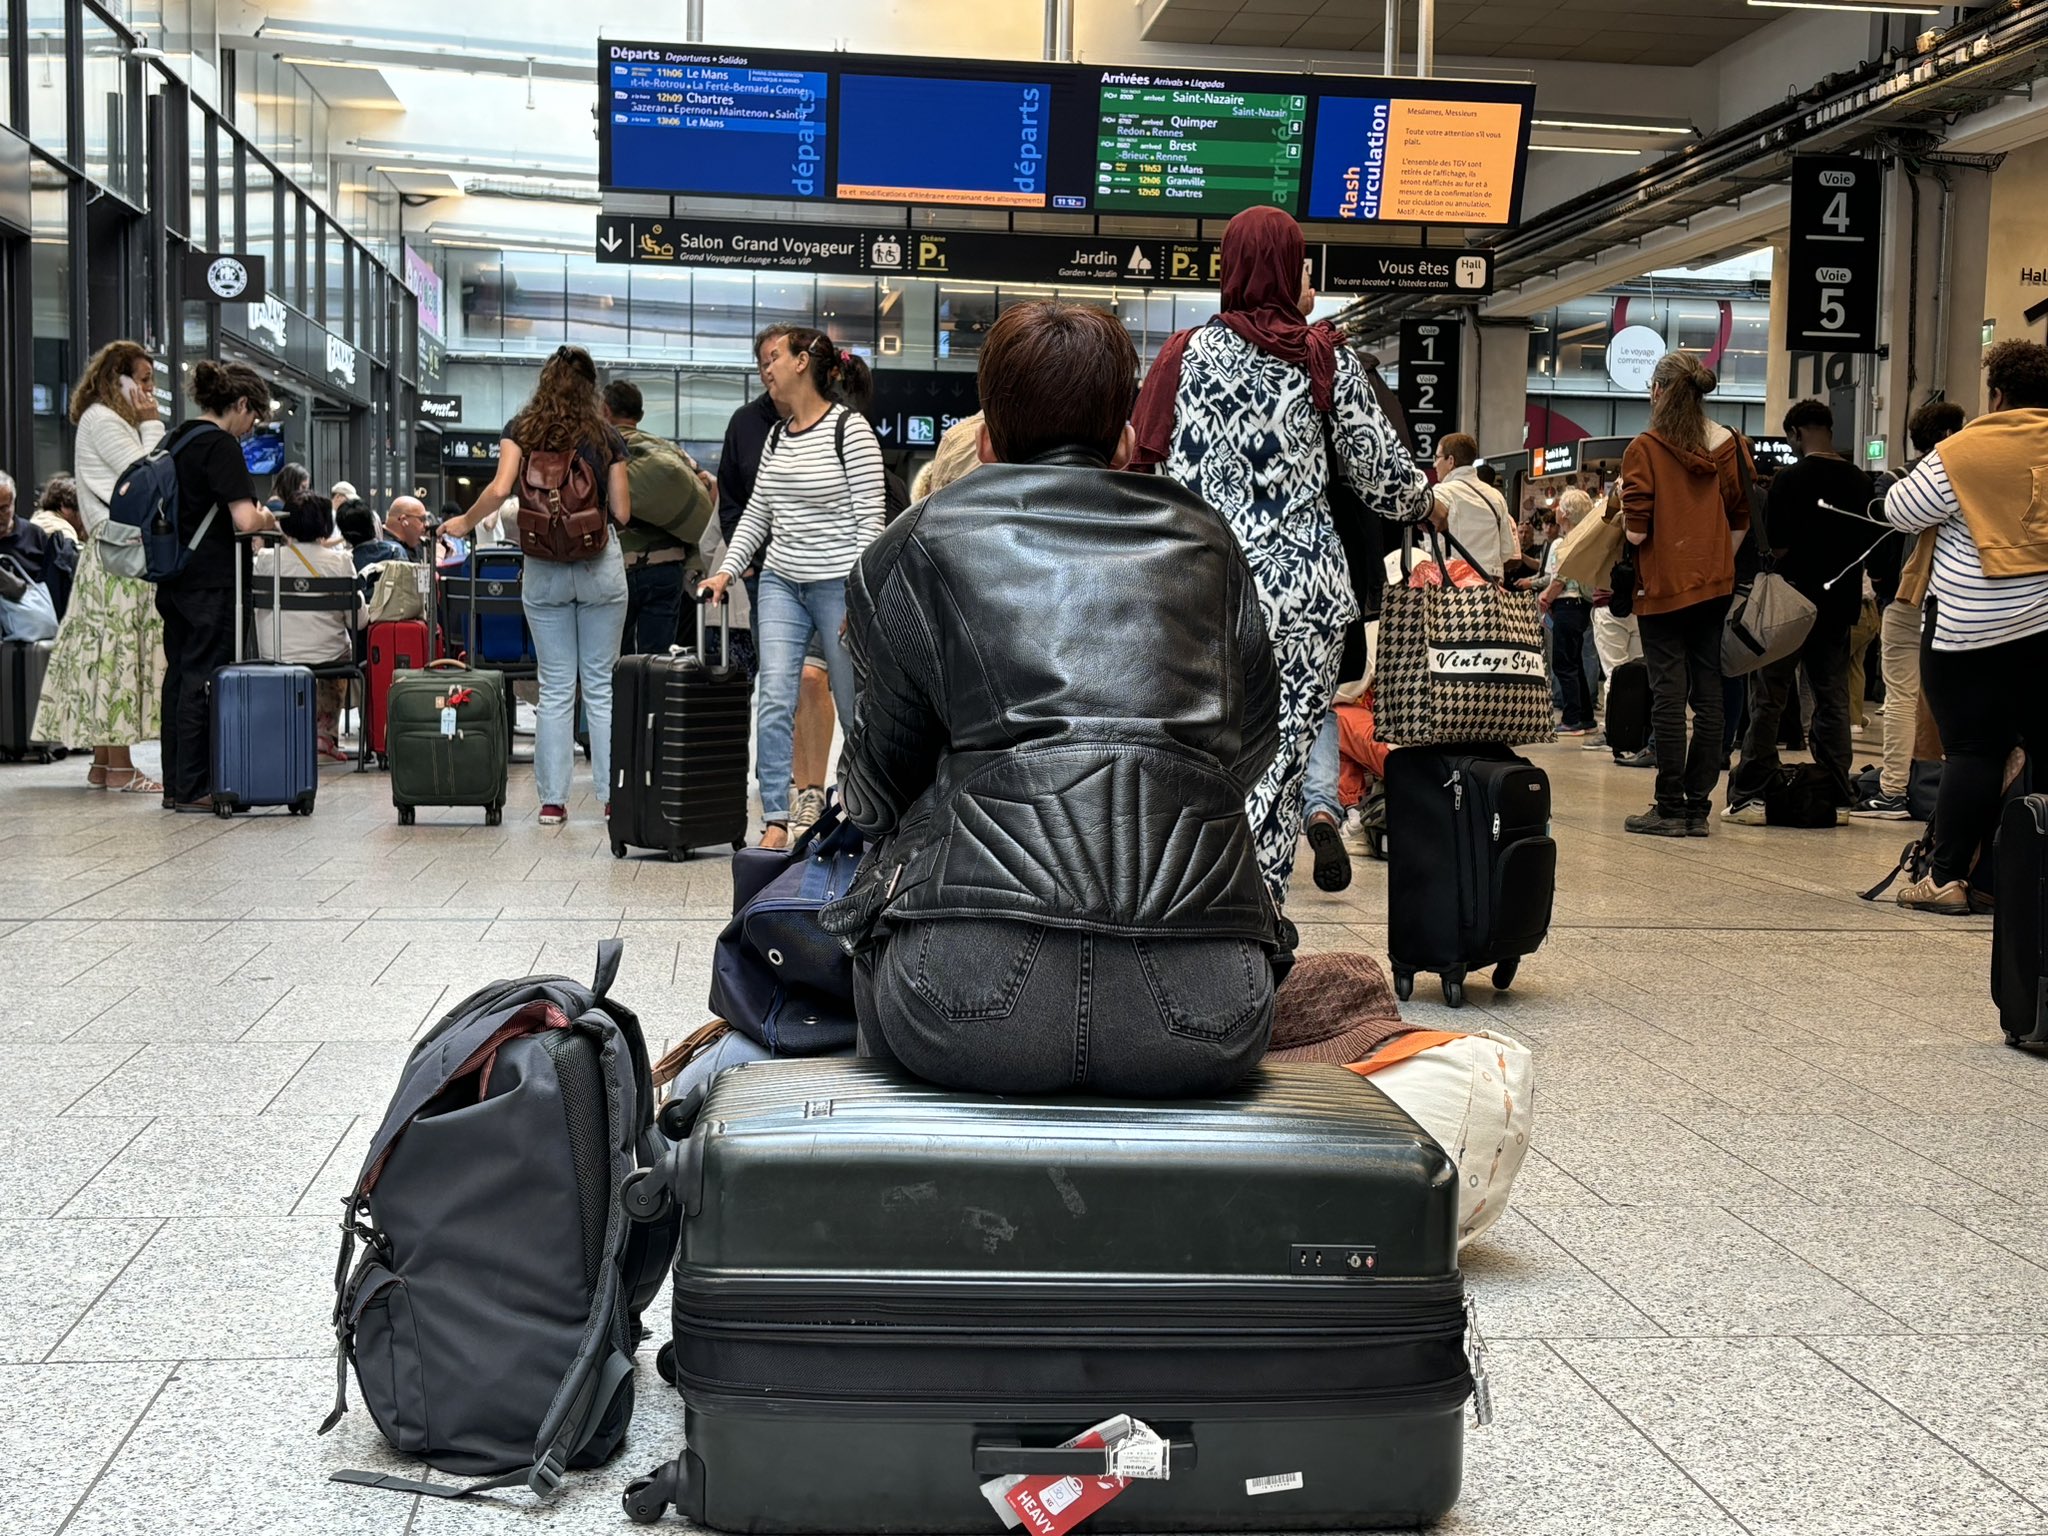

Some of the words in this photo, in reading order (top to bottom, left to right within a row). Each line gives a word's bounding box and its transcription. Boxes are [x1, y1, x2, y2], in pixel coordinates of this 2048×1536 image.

[611, 46, 660, 61] Départs
[666, 52, 710, 63] Departures
[718, 55, 748, 65] Salidas
[657, 68, 683, 78] 11h06
[687, 68, 699, 78] Le
[701, 69, 728, 80] Mans
[1101, 72, 1150, 85] Arrivées
[1153, 77, 1183, 86] Arrivals
[693, 81, 703, 90] La
[706, 81, 769, 93] Ferté-Bernard
[657, 93, 683, 102] 12h09
[686, 92, 734, 105] Chartres
[1172, 91, 1244, 105] Saint-Nazaire
[1294, 98, 1301, 107] 4
[674, 104, 712, 115] Epernon
[720, 107, 768, 118] Maintenon
[1445, 108, 1478, 117] Messieurs
[686, 117, 698, 126] Le
[700, 118, 724, 128] Mans
[1171, 116, 1218, 130] Quimper
[1293, 122, 1299, 131] 8
[1117, 126, 1145, 136] Redon
[1152, 127, 1184, 137] Rennes
[1405, 127, 1424, 136] Toute
[1444, 129, 1474, 138] attention
[792, 89, 820, 195] départs
[1013, 88, 1042, 193] départs
[1169, 140, 1197, 151] Brest
[1290, 147, 1297, 155] 8
[1156, 152, 1187, 161] Rennes
[1360, 104, 1387, 219] circulation
[1402, 158, 1439, 166] L'ensemble
[1439, 159, 1452, 167] des
[1167, 164, 1179, 173] Le
[1180, 165, 1203, 174] Mans
[1401, 168, 1422, 176] retirés
[1468, 170, 1476, 178] ils
[1166, 176, 1205, 186] Granville
[1464, 180, 1474, 188] fur
[1824, 173, 1850, 185] Voie
[1165, 188, 1203, 198] Chartres
[1339, 166, 1360, 218] flash
[1424, 188, 1432, 196] de
[1441, 189, 1482, 198] confirmation
[1484, 190, 1493, 198] de
[1397, 198, 1411, 206] leur
[1822, 192, 1850, 233] 4
[680, 233, 723, 249] Salon
[731, 235, 778, 252] Grand
[782, 238, 855, 257] Voyageur
[679, 252, 705, 262] Grand
[706, 253, 742, 264] Voyageur
[743, 255, 772, 266] Lounge
[779, 256, 797, 265] Sala
[798, 257, 812, 265] VIP
[1070, 250, 1118, 265] Jardin
[1378, 260, 1414, 275] Vous
[1418, 260, 1449, 276] êtes
[1461, 259, 1481, 269] Hall
[1058, 268, 1086, 277] Garden
[1093, 269, 1118, 278] Jardin
[1467, 272, 1474, 285] 1
[1820, 269, 1847, 281] Voie
[1333, 277, 1348, 286] You
[1362, 277, 1390, 287] located
[1398, 279, 1427, 288] Ustedes
[1428, 280, 1449, 288] estan
[1819, 288, 1845, 330] 5
[1420, 327, 1437, 335] Voie
[1422, 337, 1435, 361] 1
[1620, 346, 1630, 355] Le
[1631, 349, 1656, 358] voyage
[1617, 357, 1657, 366] commence
[1418, 375, 1435, 383] Voie
[1418, 385, 1435, 409] 2
[1416, 424, 1433, 432] Voie
[1416, 434, 1432, 458] 3
[1436, 651, 1508, 671] Vintage
[1017, 1490, 1055, 1534] HEAVY
